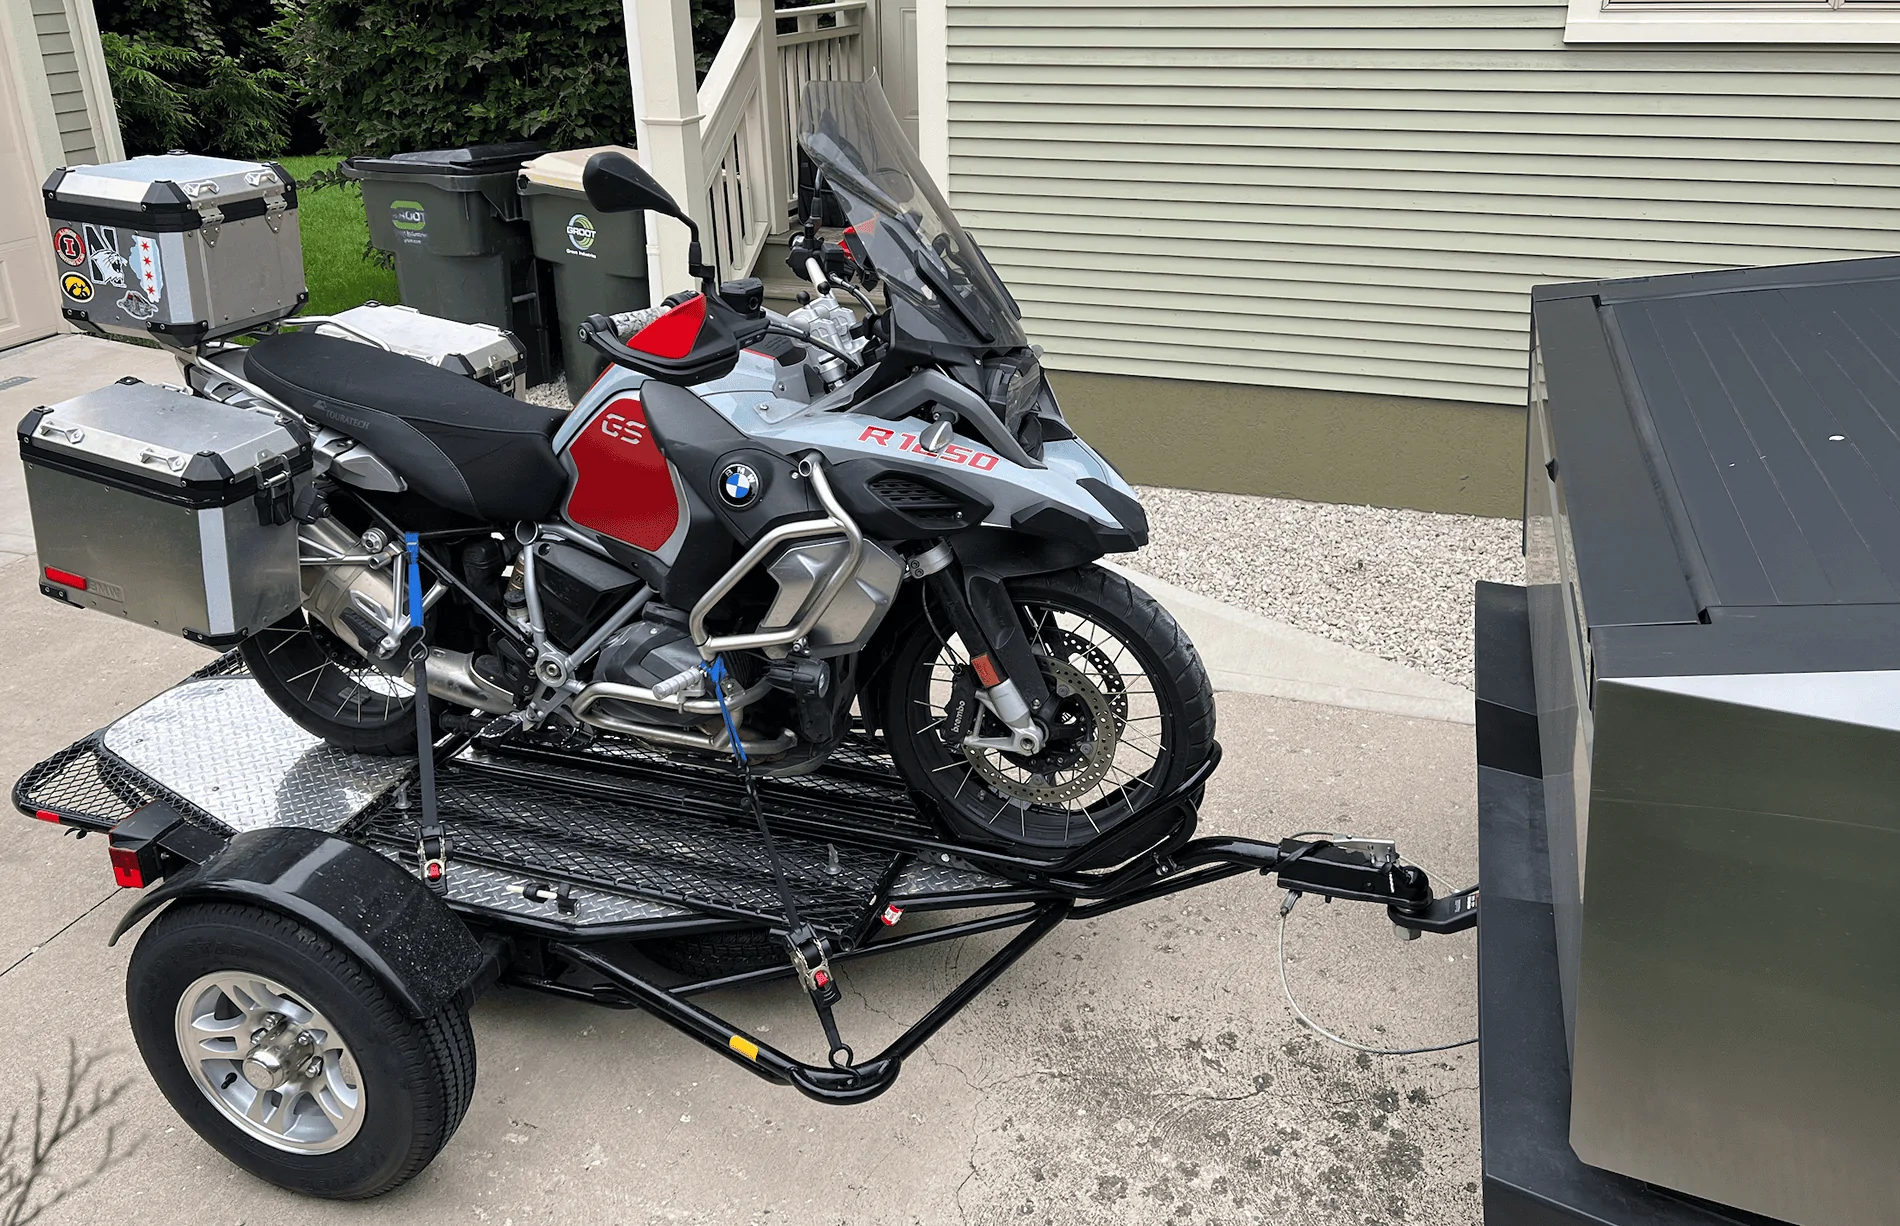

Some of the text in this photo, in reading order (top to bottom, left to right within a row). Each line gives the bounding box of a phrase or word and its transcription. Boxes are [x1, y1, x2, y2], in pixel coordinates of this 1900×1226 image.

[566, 226, 597, 239] GROOT
[326, 410, 370, 430] TOURATECH
[601, 413, 646, 445] GS
[857, 425, 895, 447] R
[725, 466, 756, 483] BMW
[950, 700, 966, 733] brembo
